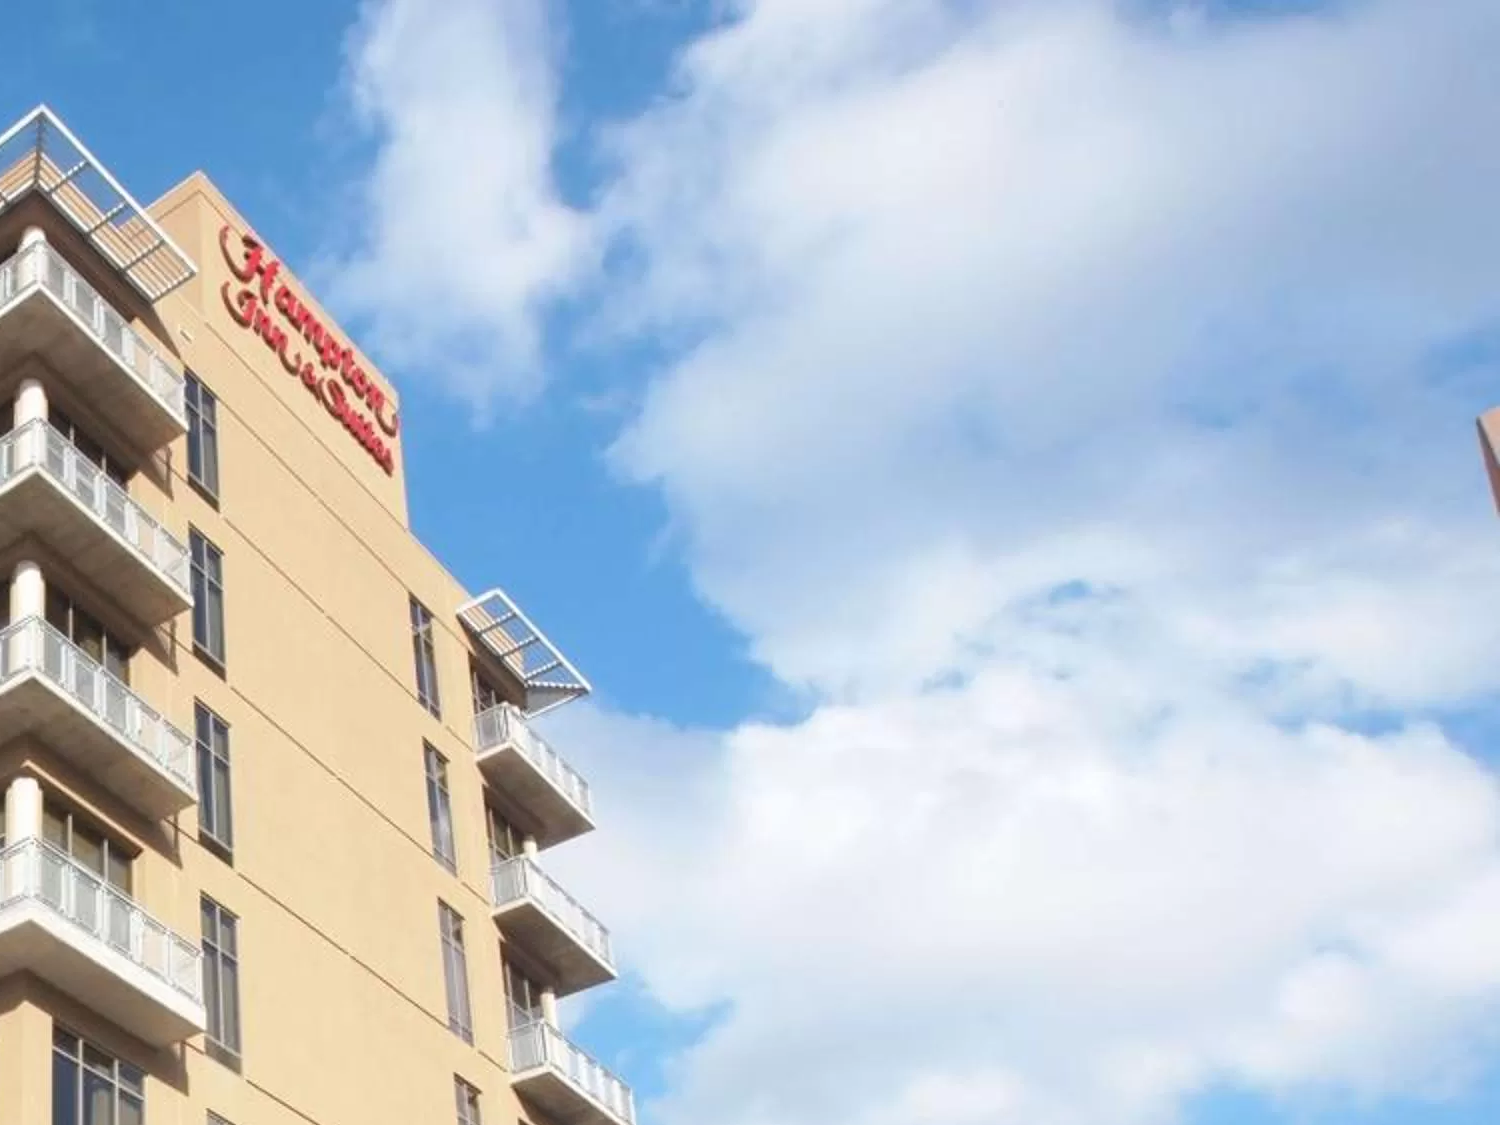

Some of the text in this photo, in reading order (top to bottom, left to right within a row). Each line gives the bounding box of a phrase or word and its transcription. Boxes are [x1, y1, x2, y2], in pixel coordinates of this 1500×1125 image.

[219, 224, 398, 438] Hampton
[220, 281, 301, 377] Inn
[317, 376, 394, 478] Suites
